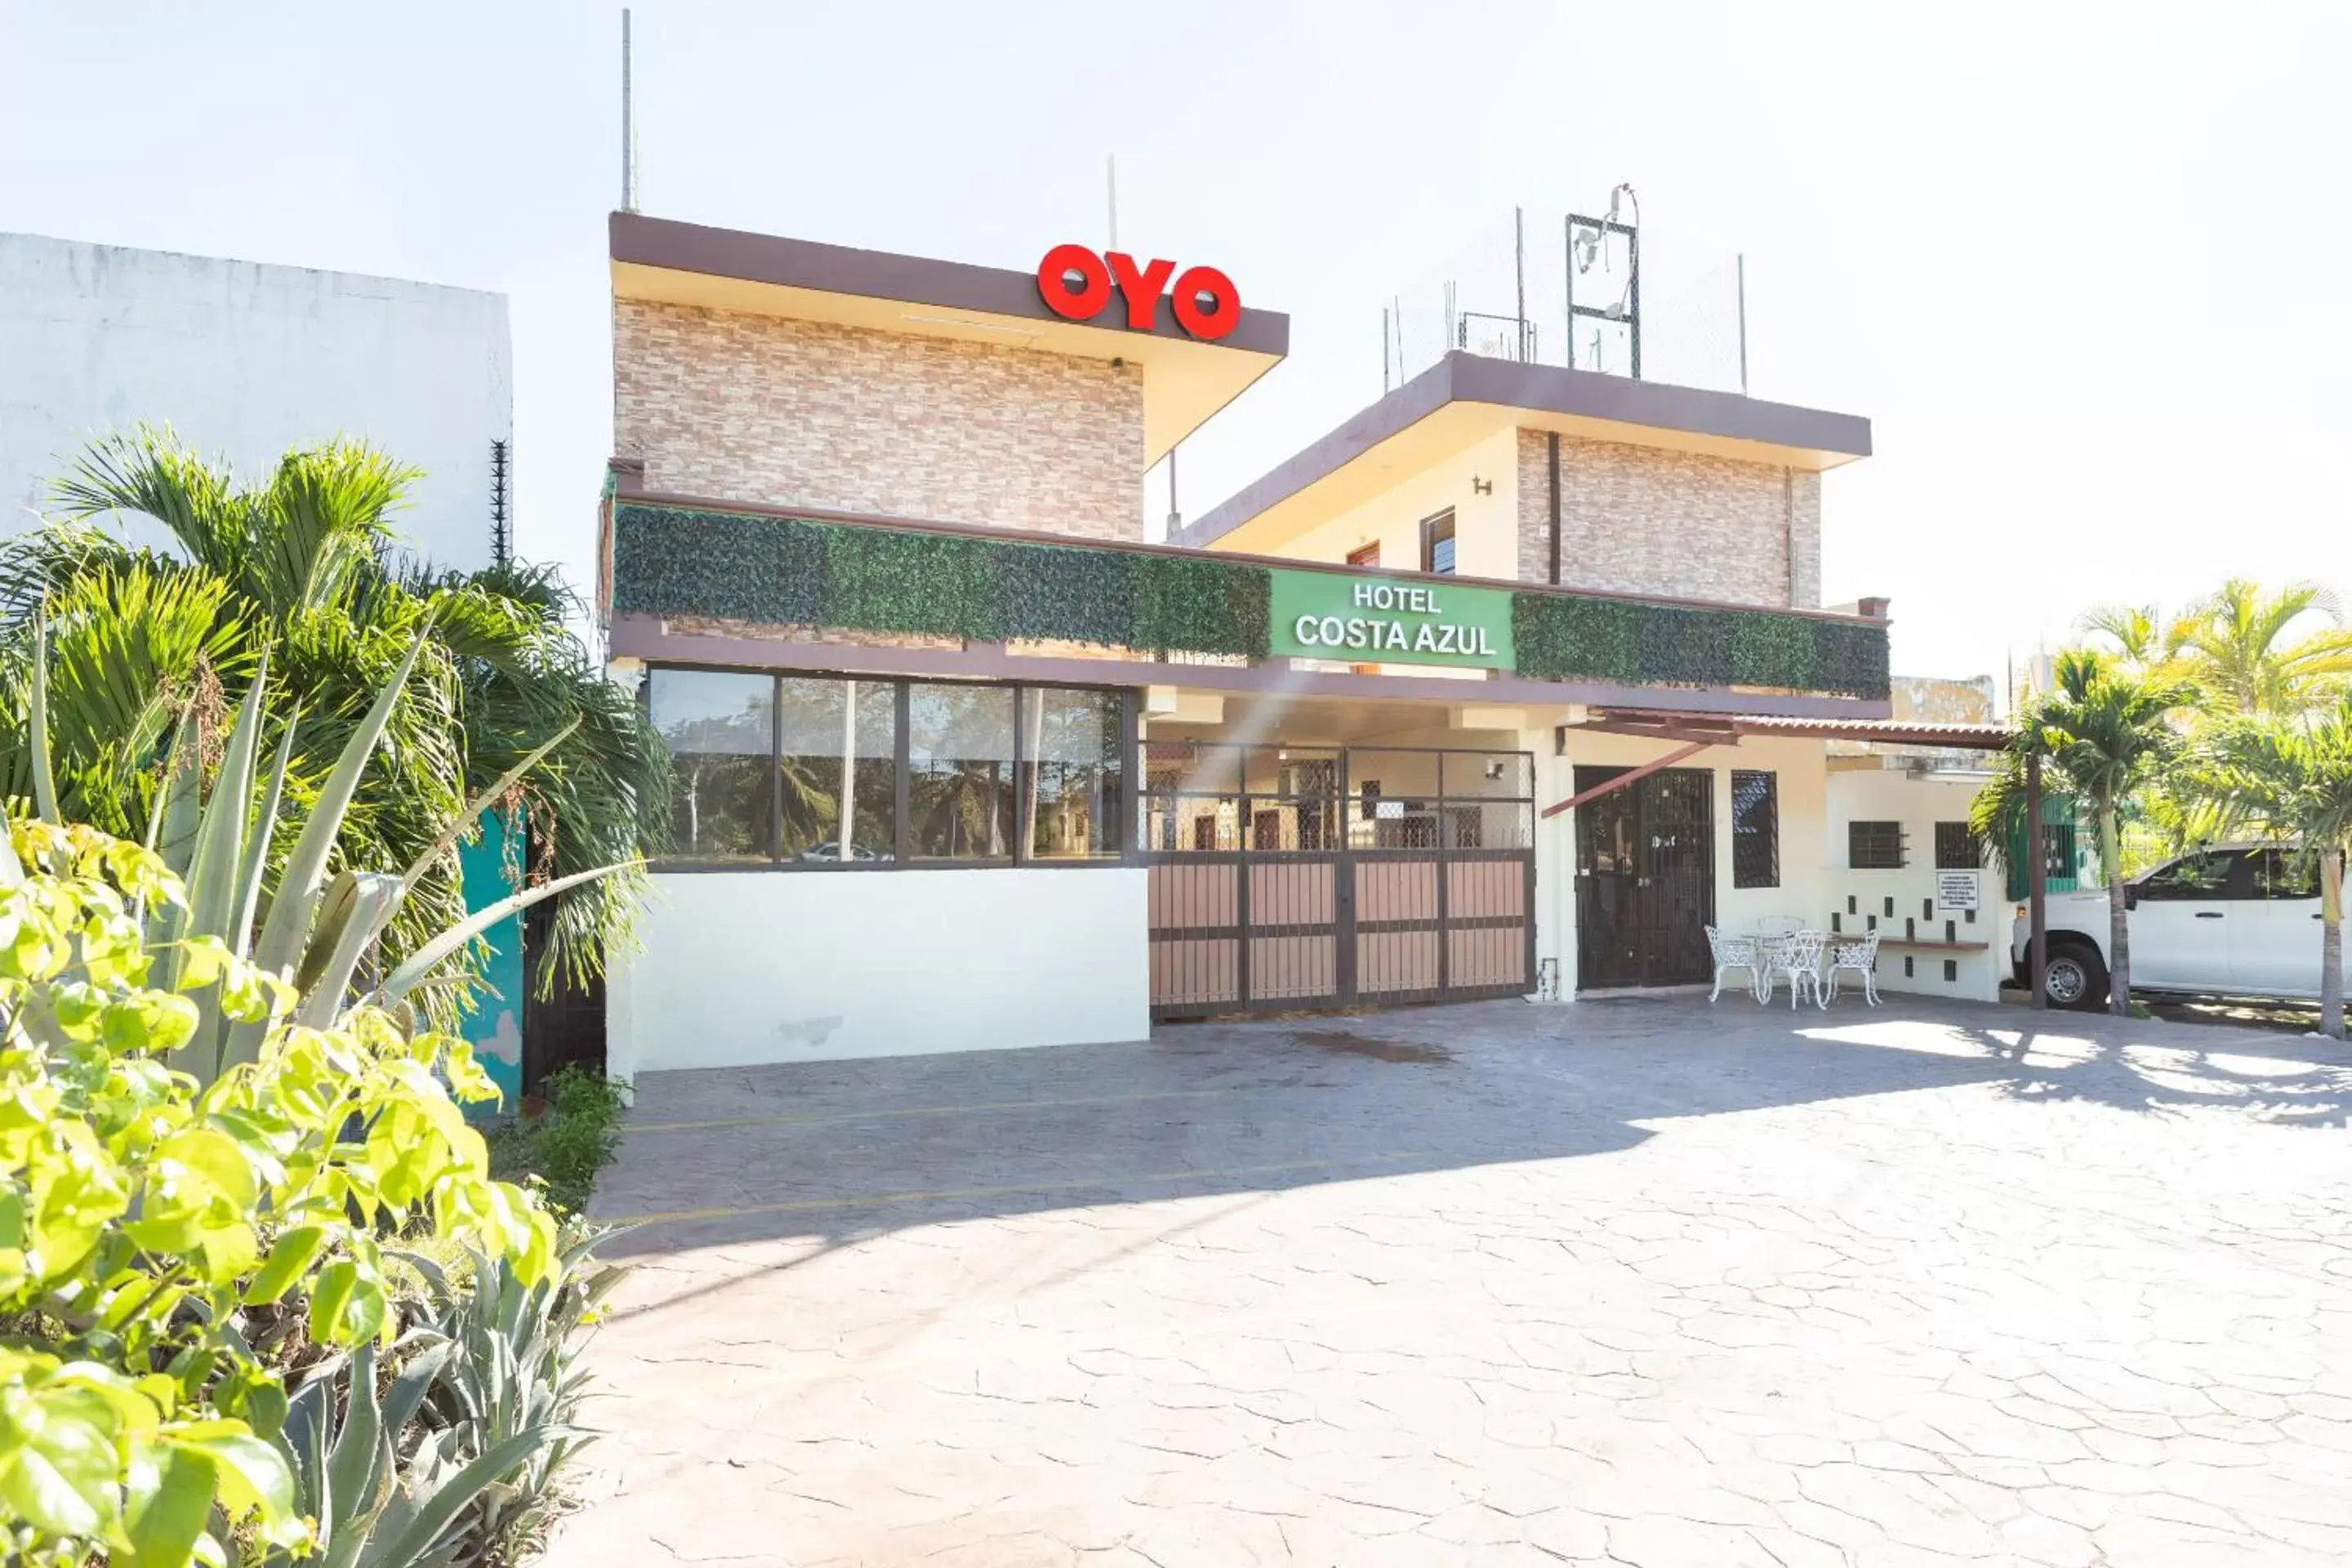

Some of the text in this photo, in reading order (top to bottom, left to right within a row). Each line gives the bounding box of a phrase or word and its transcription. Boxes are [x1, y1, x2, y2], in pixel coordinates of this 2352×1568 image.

[1036, 243, 1241, 341] OYO
[1353, 582, 1442, 614] HOTEL
[1295, 614, 1497, 656] COSTA AZUL
